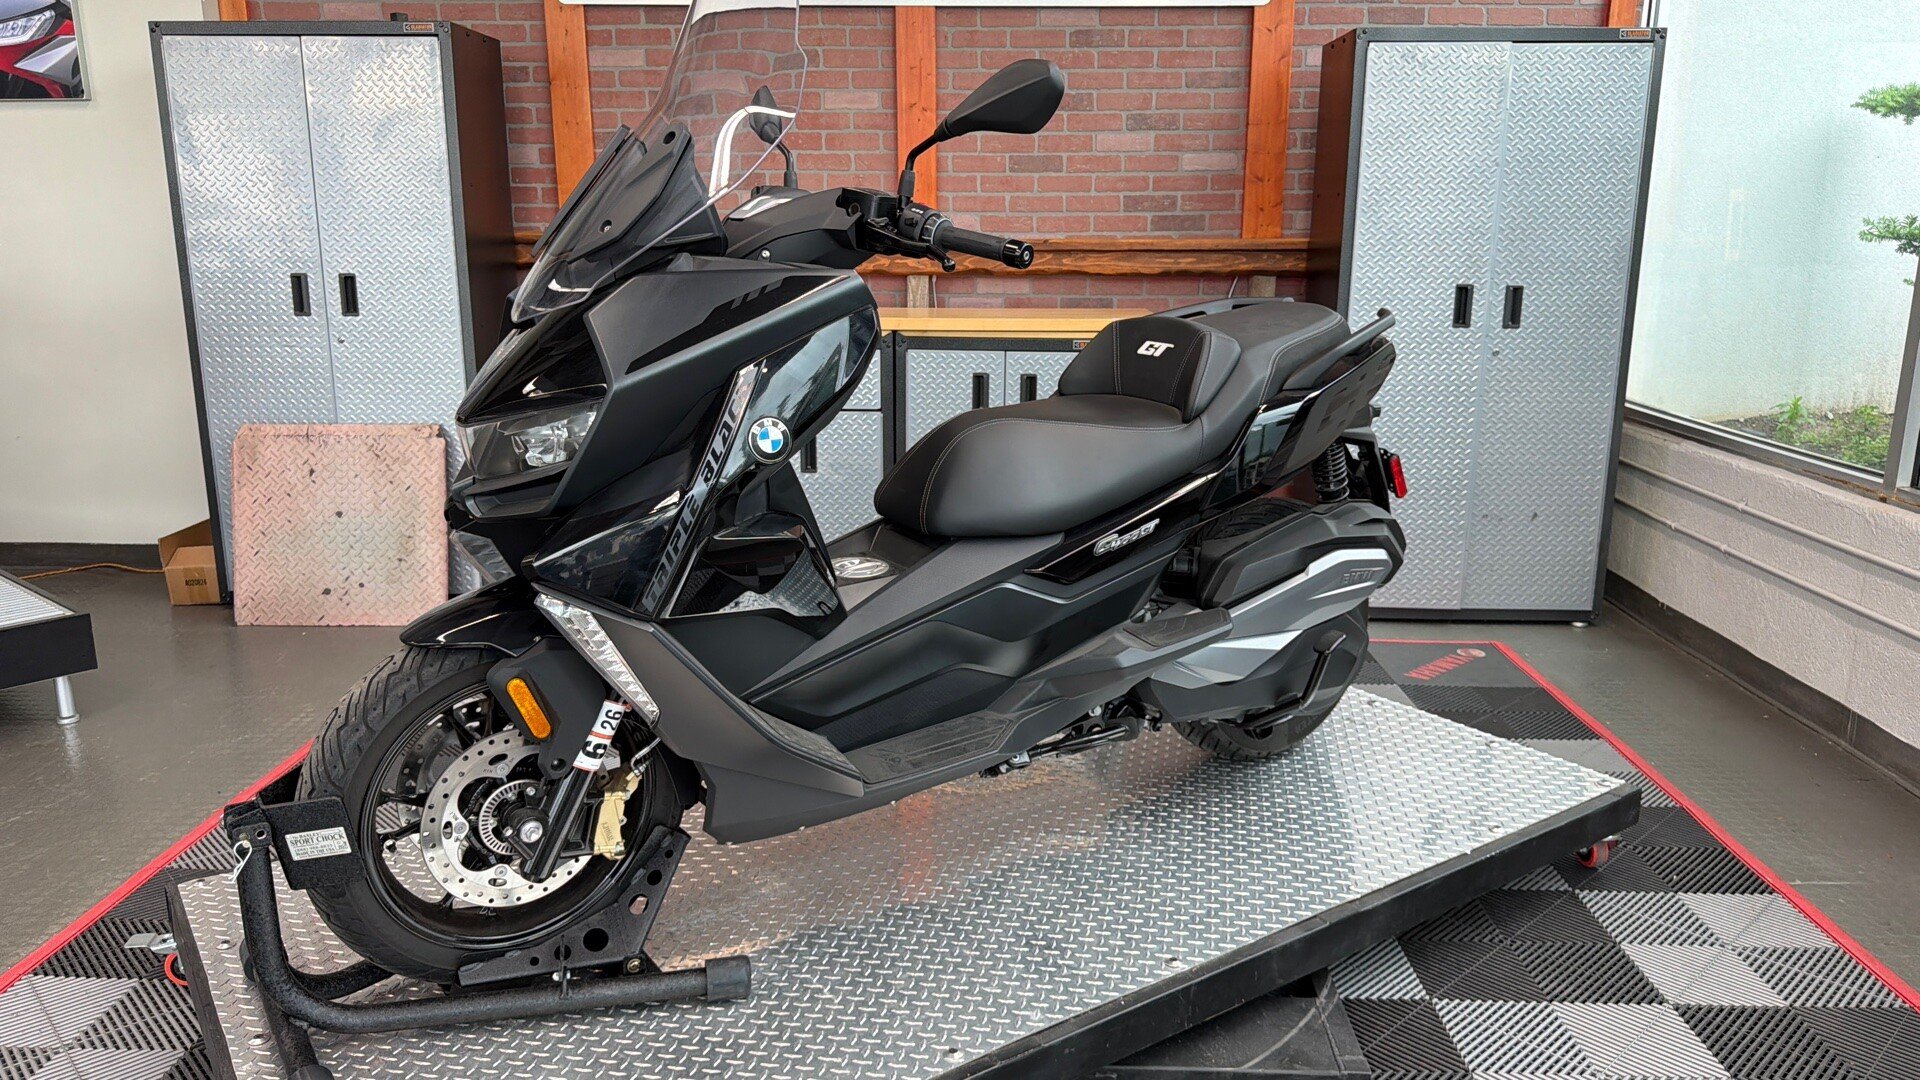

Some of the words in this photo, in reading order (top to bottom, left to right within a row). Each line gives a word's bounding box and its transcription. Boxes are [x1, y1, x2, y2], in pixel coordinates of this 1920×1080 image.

[1136, 340, 1175, 357] GT
[751, 418, 787, 435] BMW
[644, 492, 701, 605] TRIPLE
[700, 382, 752, 485] BLAC
[600, 709, 622, 731] 26
[290, 837, 315, 846] SPORT
[316, 833, 345, 843] CHOCK
